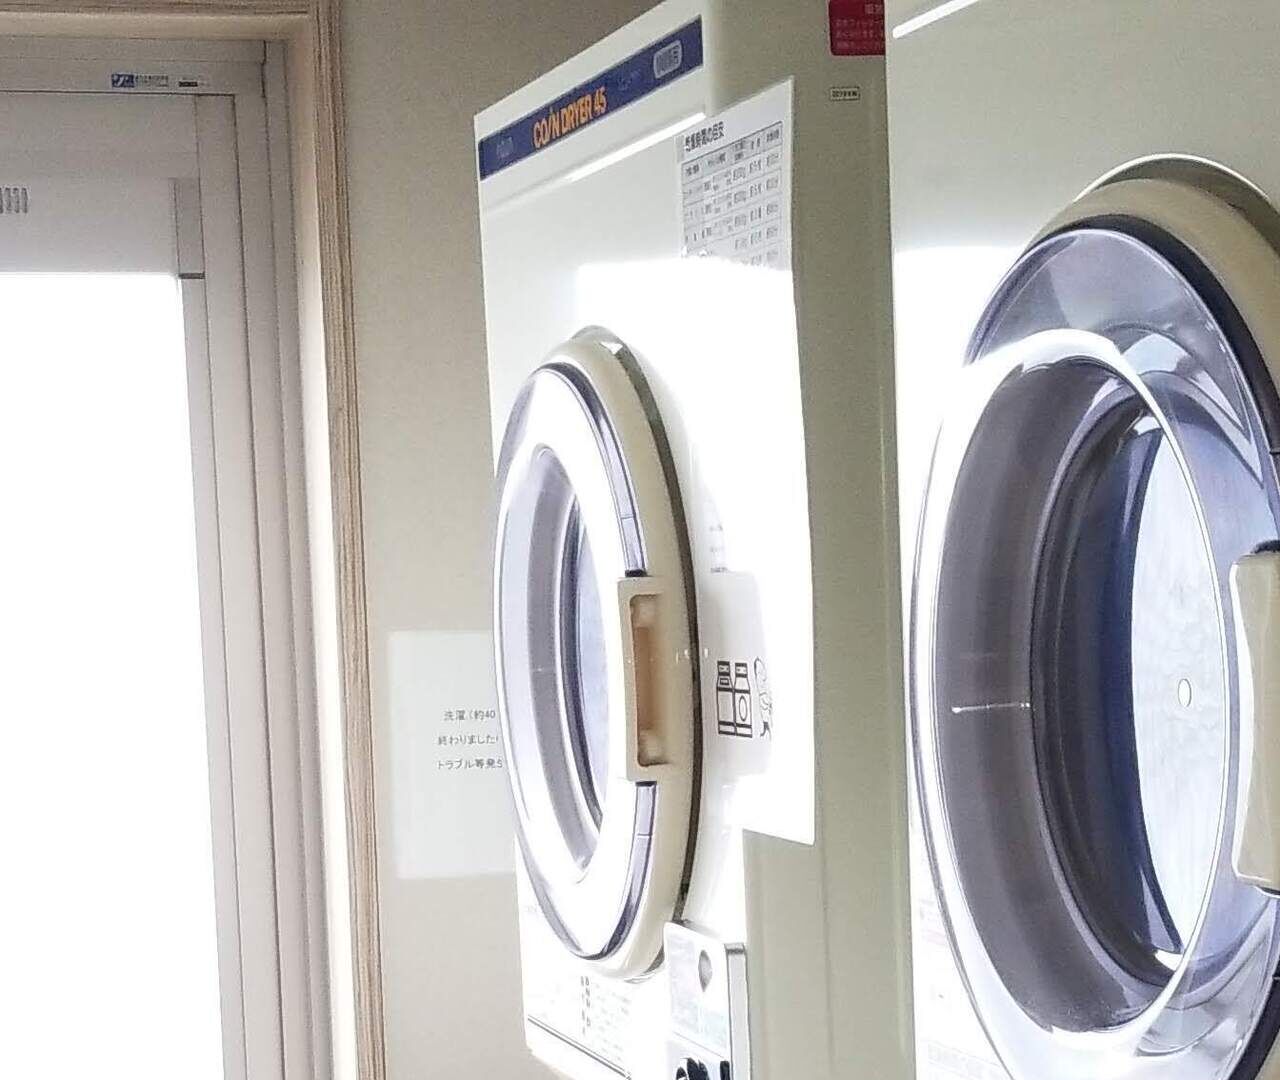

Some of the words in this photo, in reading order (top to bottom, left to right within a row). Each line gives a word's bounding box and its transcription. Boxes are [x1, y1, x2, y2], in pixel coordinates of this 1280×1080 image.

[560, 93, 592, 134] DRYER
[437, 735, 499, 746] 終わりました
